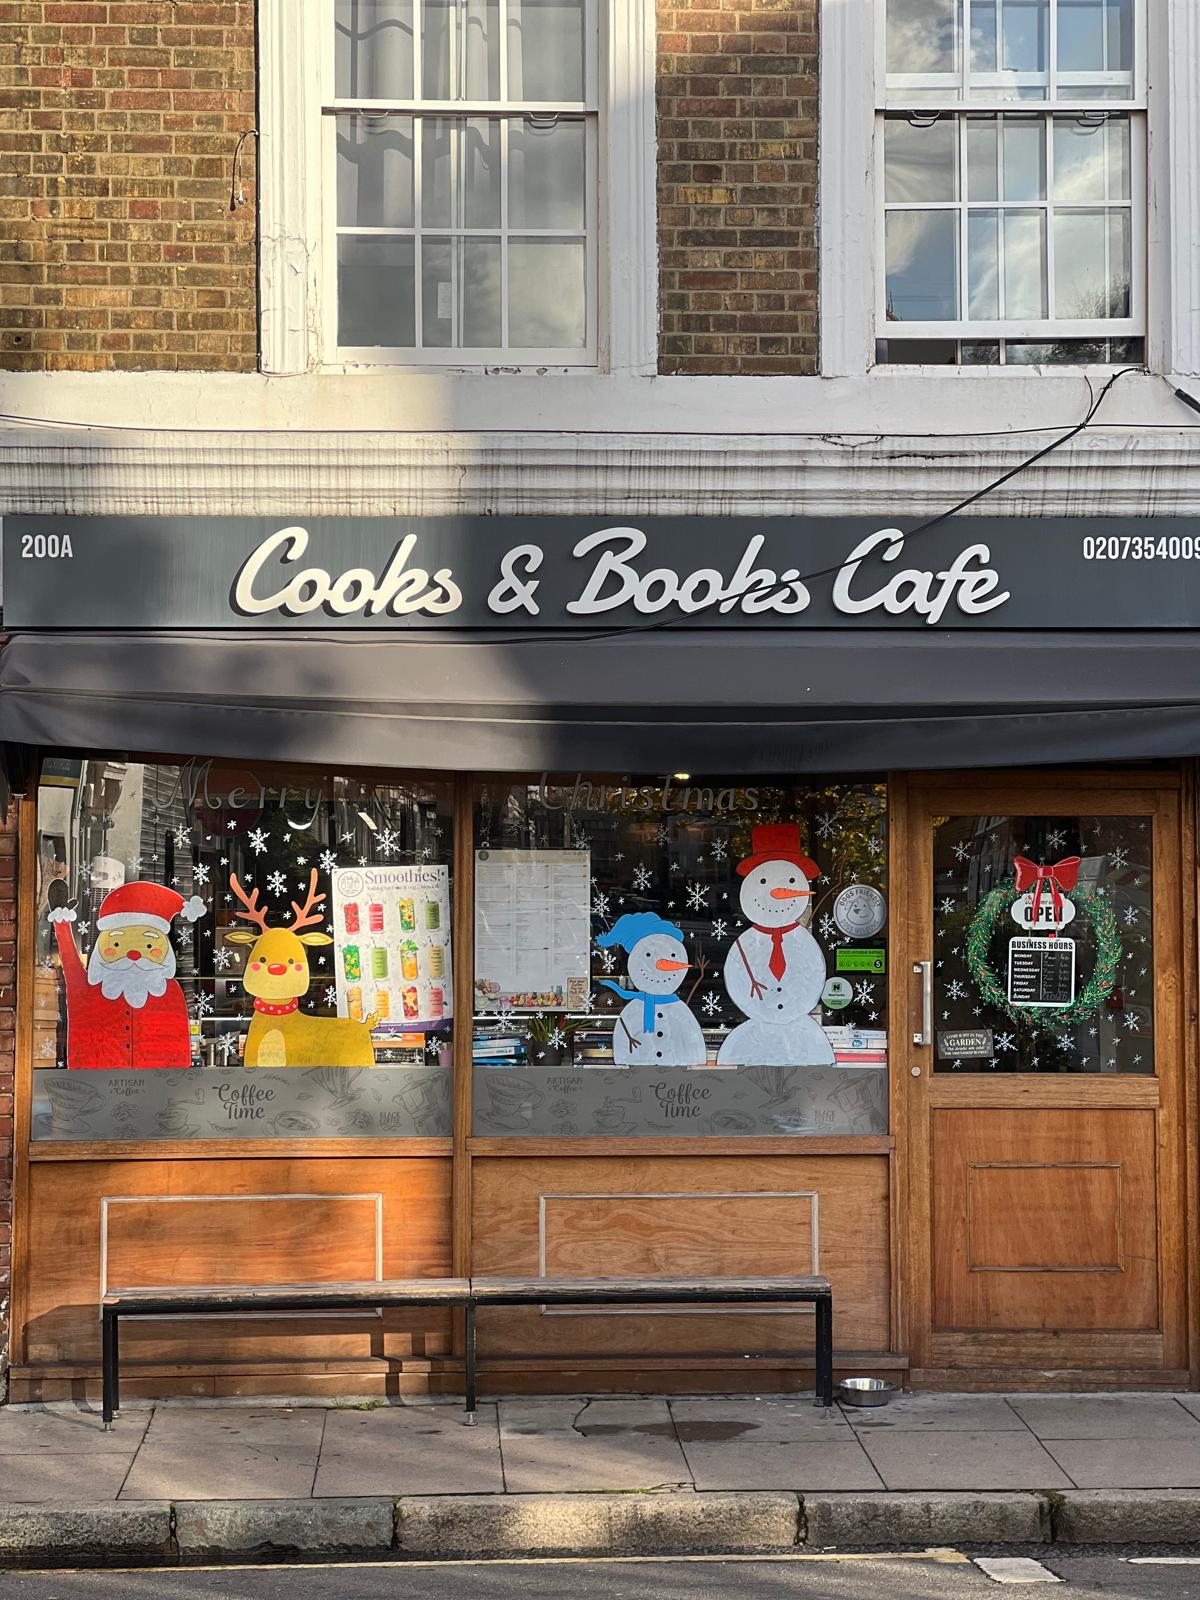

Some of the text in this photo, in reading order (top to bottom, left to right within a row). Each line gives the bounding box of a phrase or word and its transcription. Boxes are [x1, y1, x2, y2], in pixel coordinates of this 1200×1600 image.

[21, 534, 73, 558] 200A
[232, 526, 1011, 626] Cooks & Books Cafe
[152, 756, 759, 829] Merry Christmas
[364, 868, 441, 885] Smoothies!
[840, 889, 881, 907] DOGS FRIENDLY
[1024, 906, 1063, 922] OPEN
[1011, 941, 1073, 950] BUSINESS HOURS
[875, 960, 881, 968] 5
[949, 1038, 981, 1046] GARDEN
[109, 1079, 145, 1087] ARTISAN
[211, 1083, 277, 1106] Coffee
[648, 1082, 712, 1105] Coffee
[223, 1101, 265, 1120] Time
[660, 1100, 702, 1118] Time
